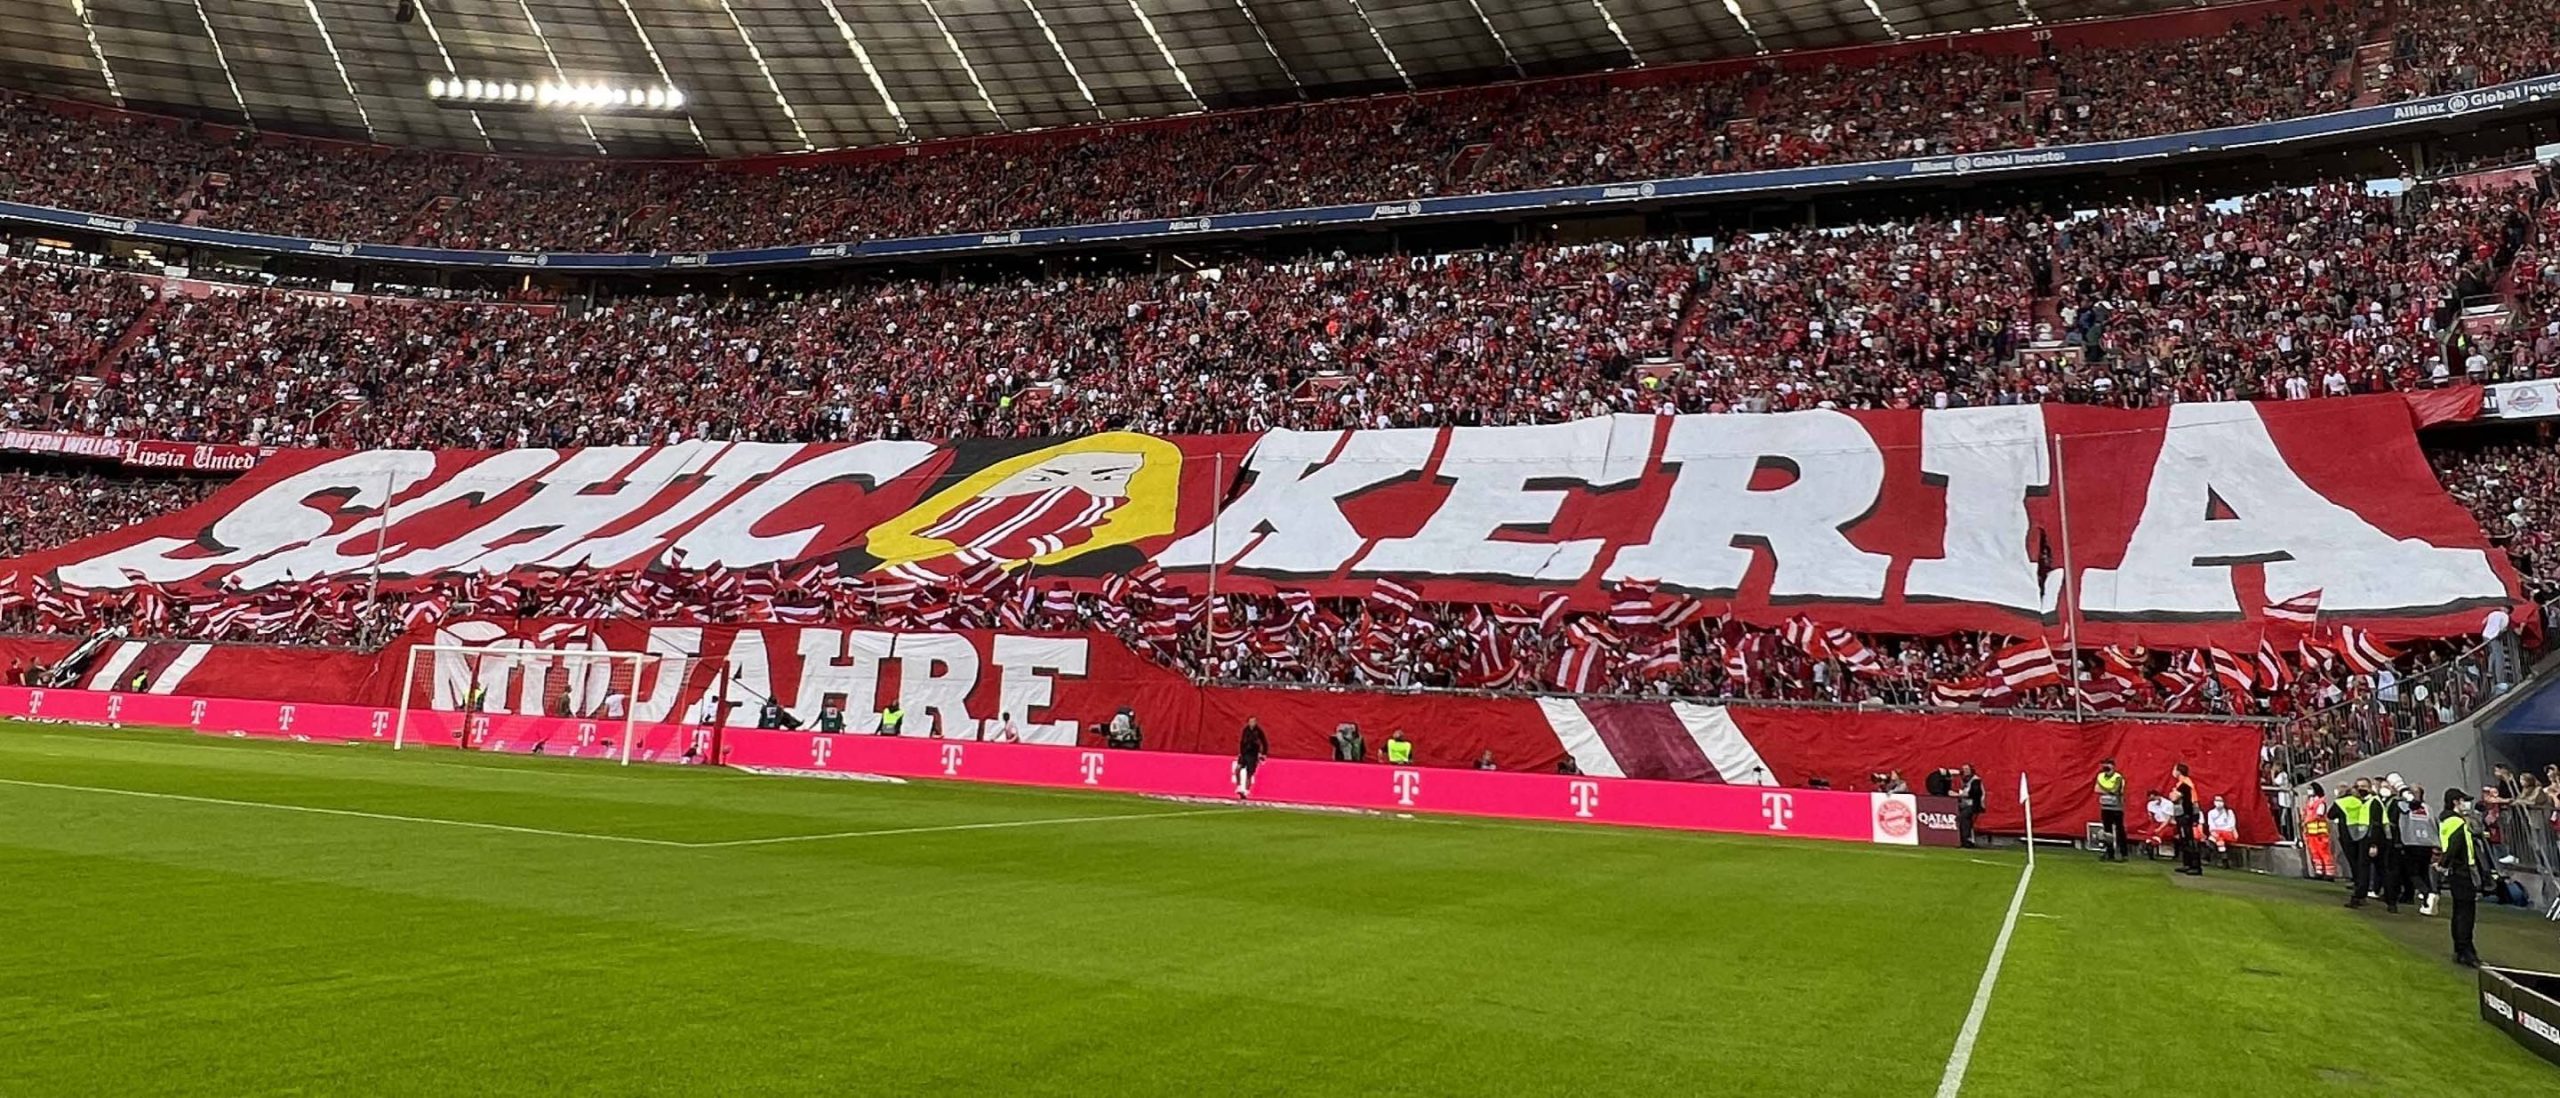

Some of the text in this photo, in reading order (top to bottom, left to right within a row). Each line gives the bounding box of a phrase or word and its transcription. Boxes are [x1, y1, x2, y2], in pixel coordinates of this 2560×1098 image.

[2394, 103, 2446, 119] Allianz
[2471, 87, 2521, 106] Global
[1911, 162, 1952, 173] Allianz
[1973, 155, 2012, 168] Global
[1603, 186, 1639, 198] Allianz
[1376, 205, 1406, 215] Allianz
[87, 216, 122, 230] Allianz
[1169, 221, 1198, 231] Allianz
[309, 242, 341, 253] Allianz
[810, 247, 836, 256] Allianz
[982, 235, 1010, 245] Allianz
[507, 255, 537, 265] Allianz
[671, 254, 697, 264] Allianz
[123, 440, 256, 470] Lipsia United
[29, 690, 43, 714] T
[107, 695, 122, 719] T
[191, 699, 207, 725] T
[279, 705, 296, 731] T
[372, 710, 389, 737] T
[471, 716, 490, 744] T
[578, 723, 596, 747] T
[811, 736, 832, 766] T
[942, 744, 963, 775] T
[1081, 752, 1104, 785] T
[1393, 770, 1420, 805] T
[1570, 780, 1598, 818] T
[1762, 792, 1793, 831] T
[1918, 812, 1957, 824] QATAR
